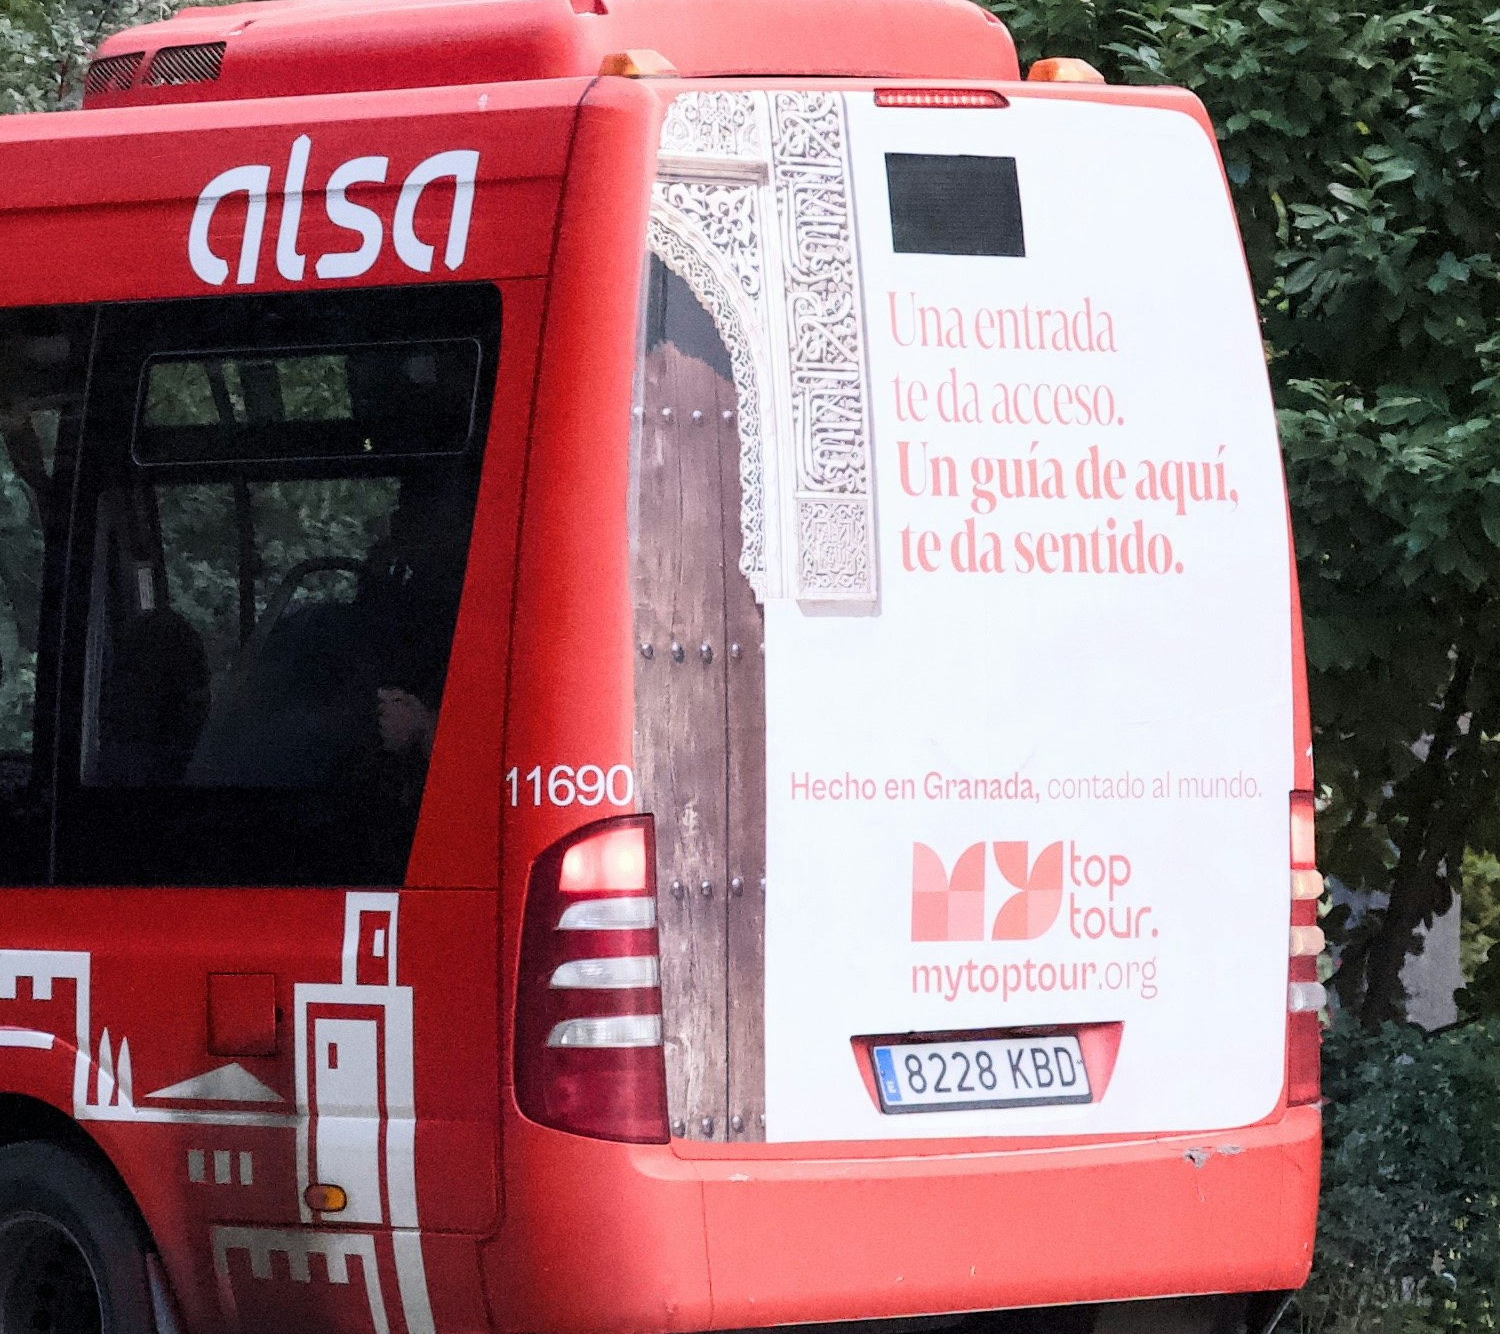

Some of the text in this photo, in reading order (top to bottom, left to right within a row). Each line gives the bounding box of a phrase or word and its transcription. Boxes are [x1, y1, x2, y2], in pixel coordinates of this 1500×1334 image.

[188, 134, 480, 285] alsa
[888, 291, 1118, 352] Una entrada
[891, 367, 1125, 426] te da acceso.
[897, 441, 1239, 516] Un guía de aquí,
[899, 523, 941, 572] te
[950, 517, 1006, 574] da
[1014, 517, 1184, 575] sentido.
[505, 764, 634, 807] 11690
[791, 770, 1263, 804] Hecho en Granada, contado al mundo.
[1069, 839, 1132, 902] top
[1069, 891, 1159, 940] tour.
[911, 956, 1159, 1002] mytoptour.org
[904, 1050, 999, 1095] 8228
[1006, 1046, 1078, 1090] KBD
